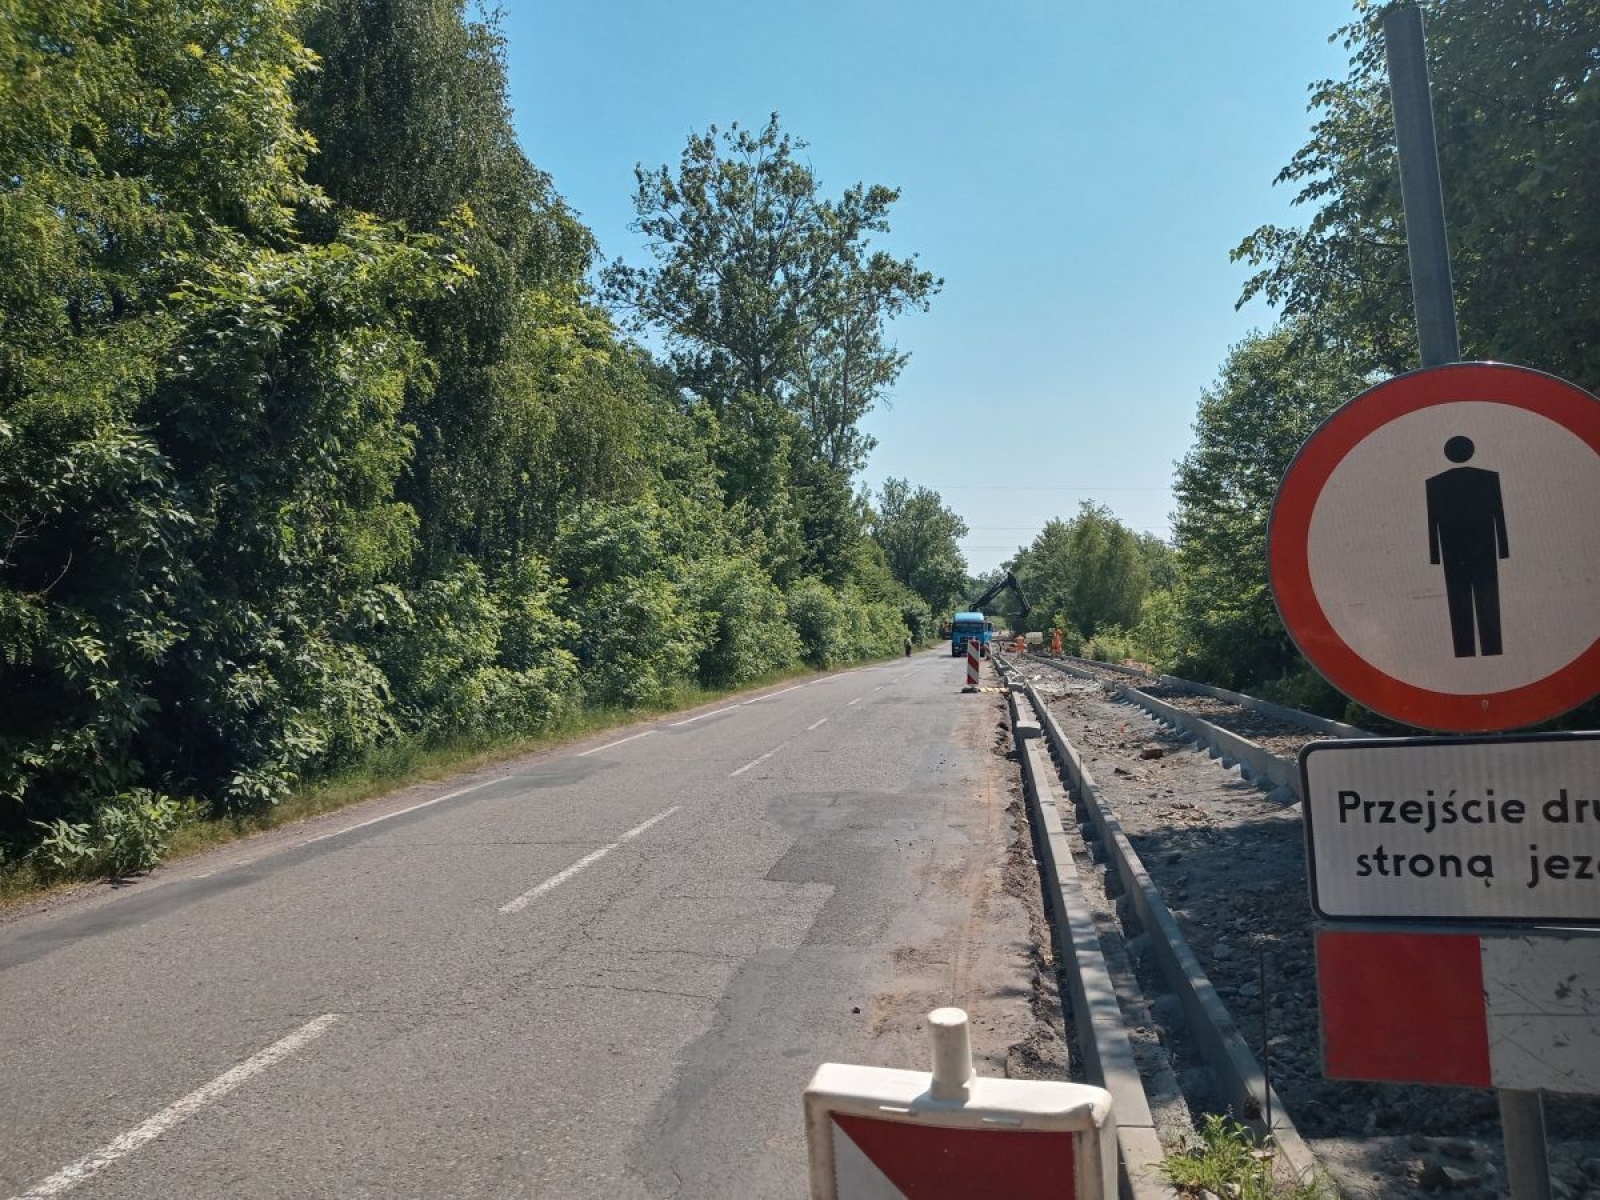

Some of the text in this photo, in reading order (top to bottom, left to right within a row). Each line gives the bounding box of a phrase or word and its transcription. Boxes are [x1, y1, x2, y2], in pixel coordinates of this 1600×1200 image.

[1338, 789, 1526, 833] Przejście
[1356, 843, 1600, 889] stroną jez
